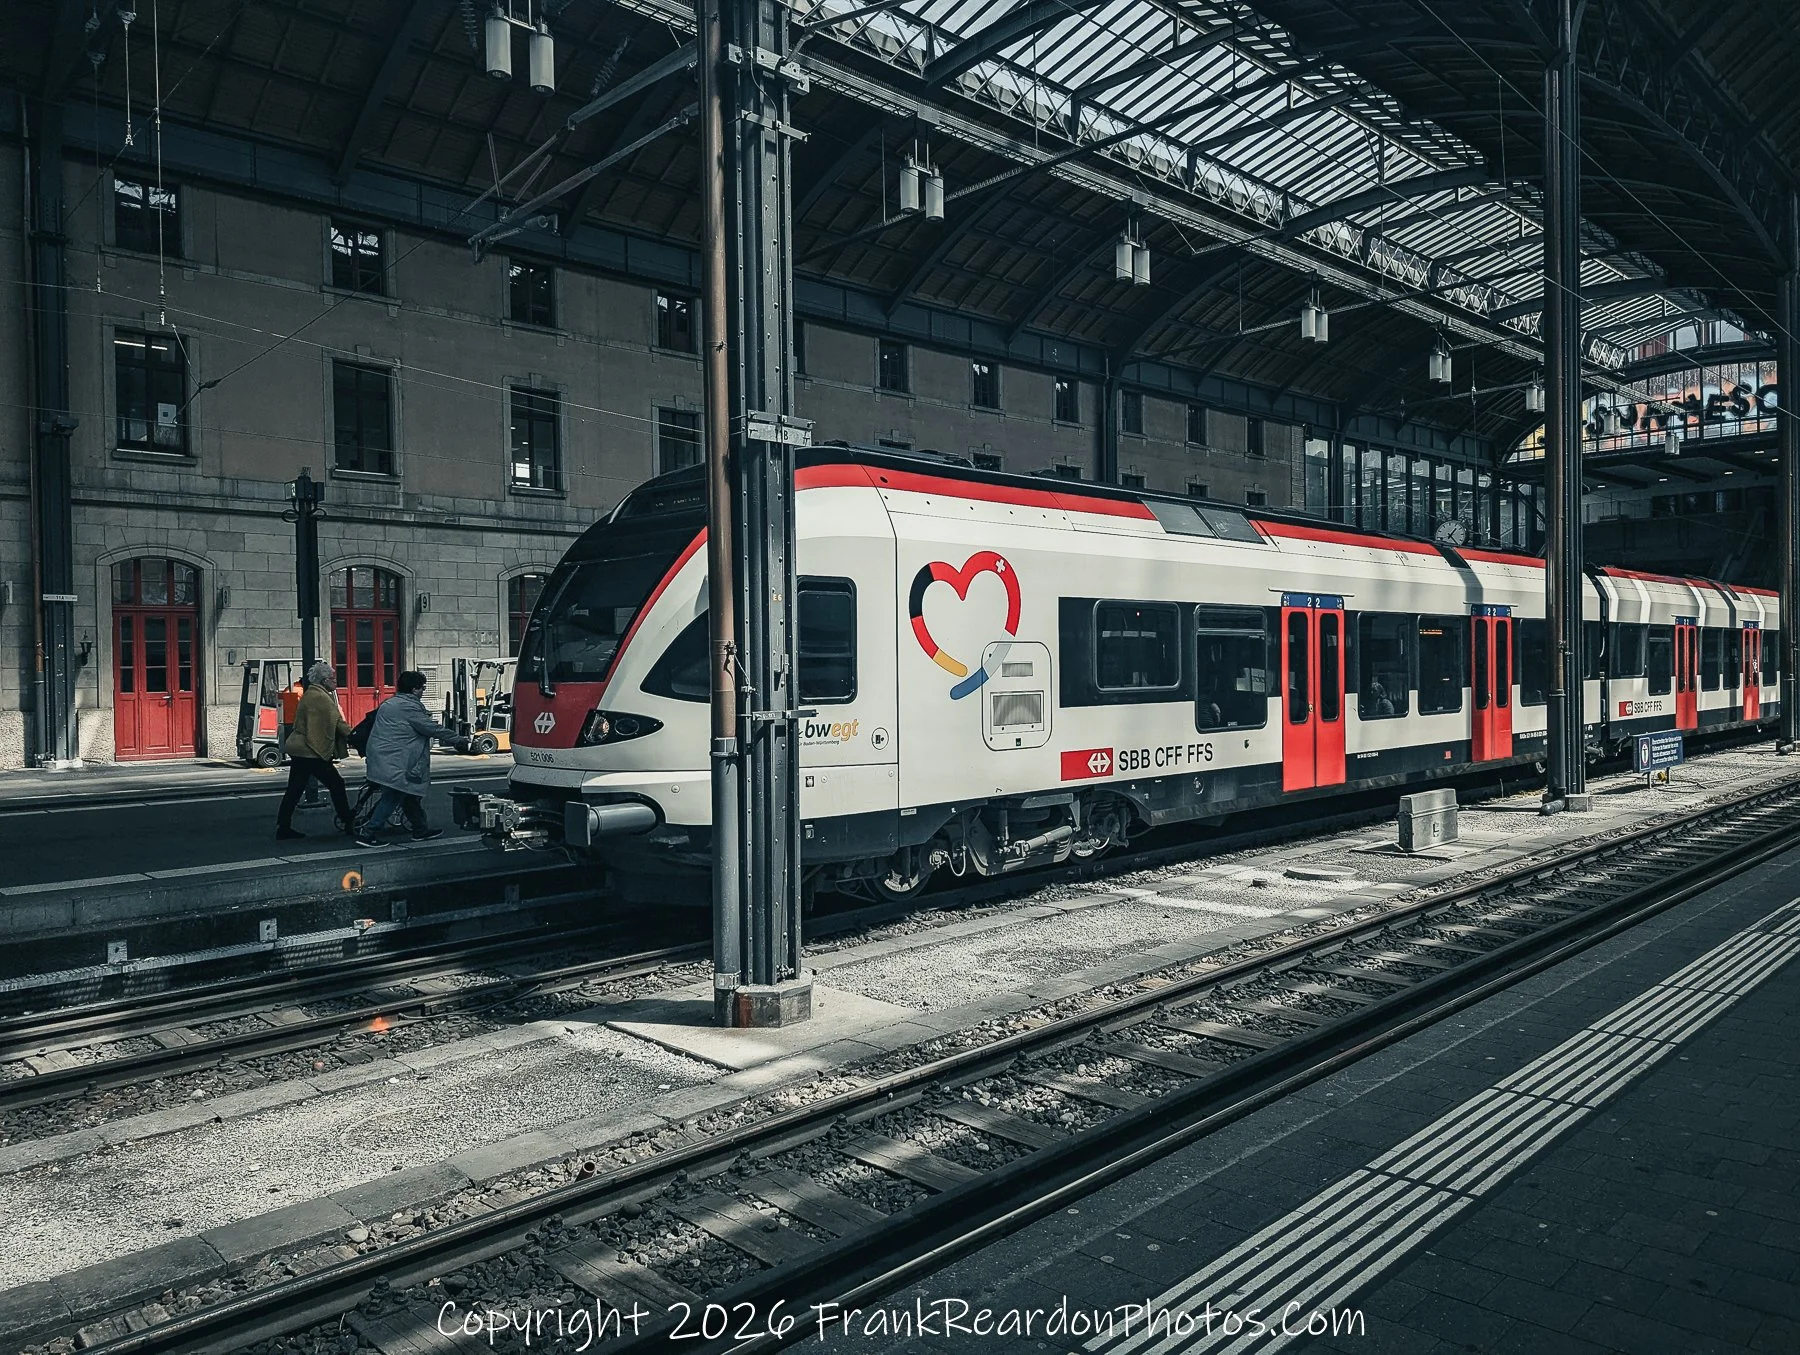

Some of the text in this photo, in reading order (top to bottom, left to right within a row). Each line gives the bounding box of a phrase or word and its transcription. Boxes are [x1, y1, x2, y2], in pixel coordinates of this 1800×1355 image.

[423, 596, 428, 608] 9
[1307, 597, 1321, 608] 2 2
[1487, 608, 1497, 616] 2 2
[805, 719, 859, 741] bwegt
[1119, 742, 1213, 771] SBB CFF FFS
